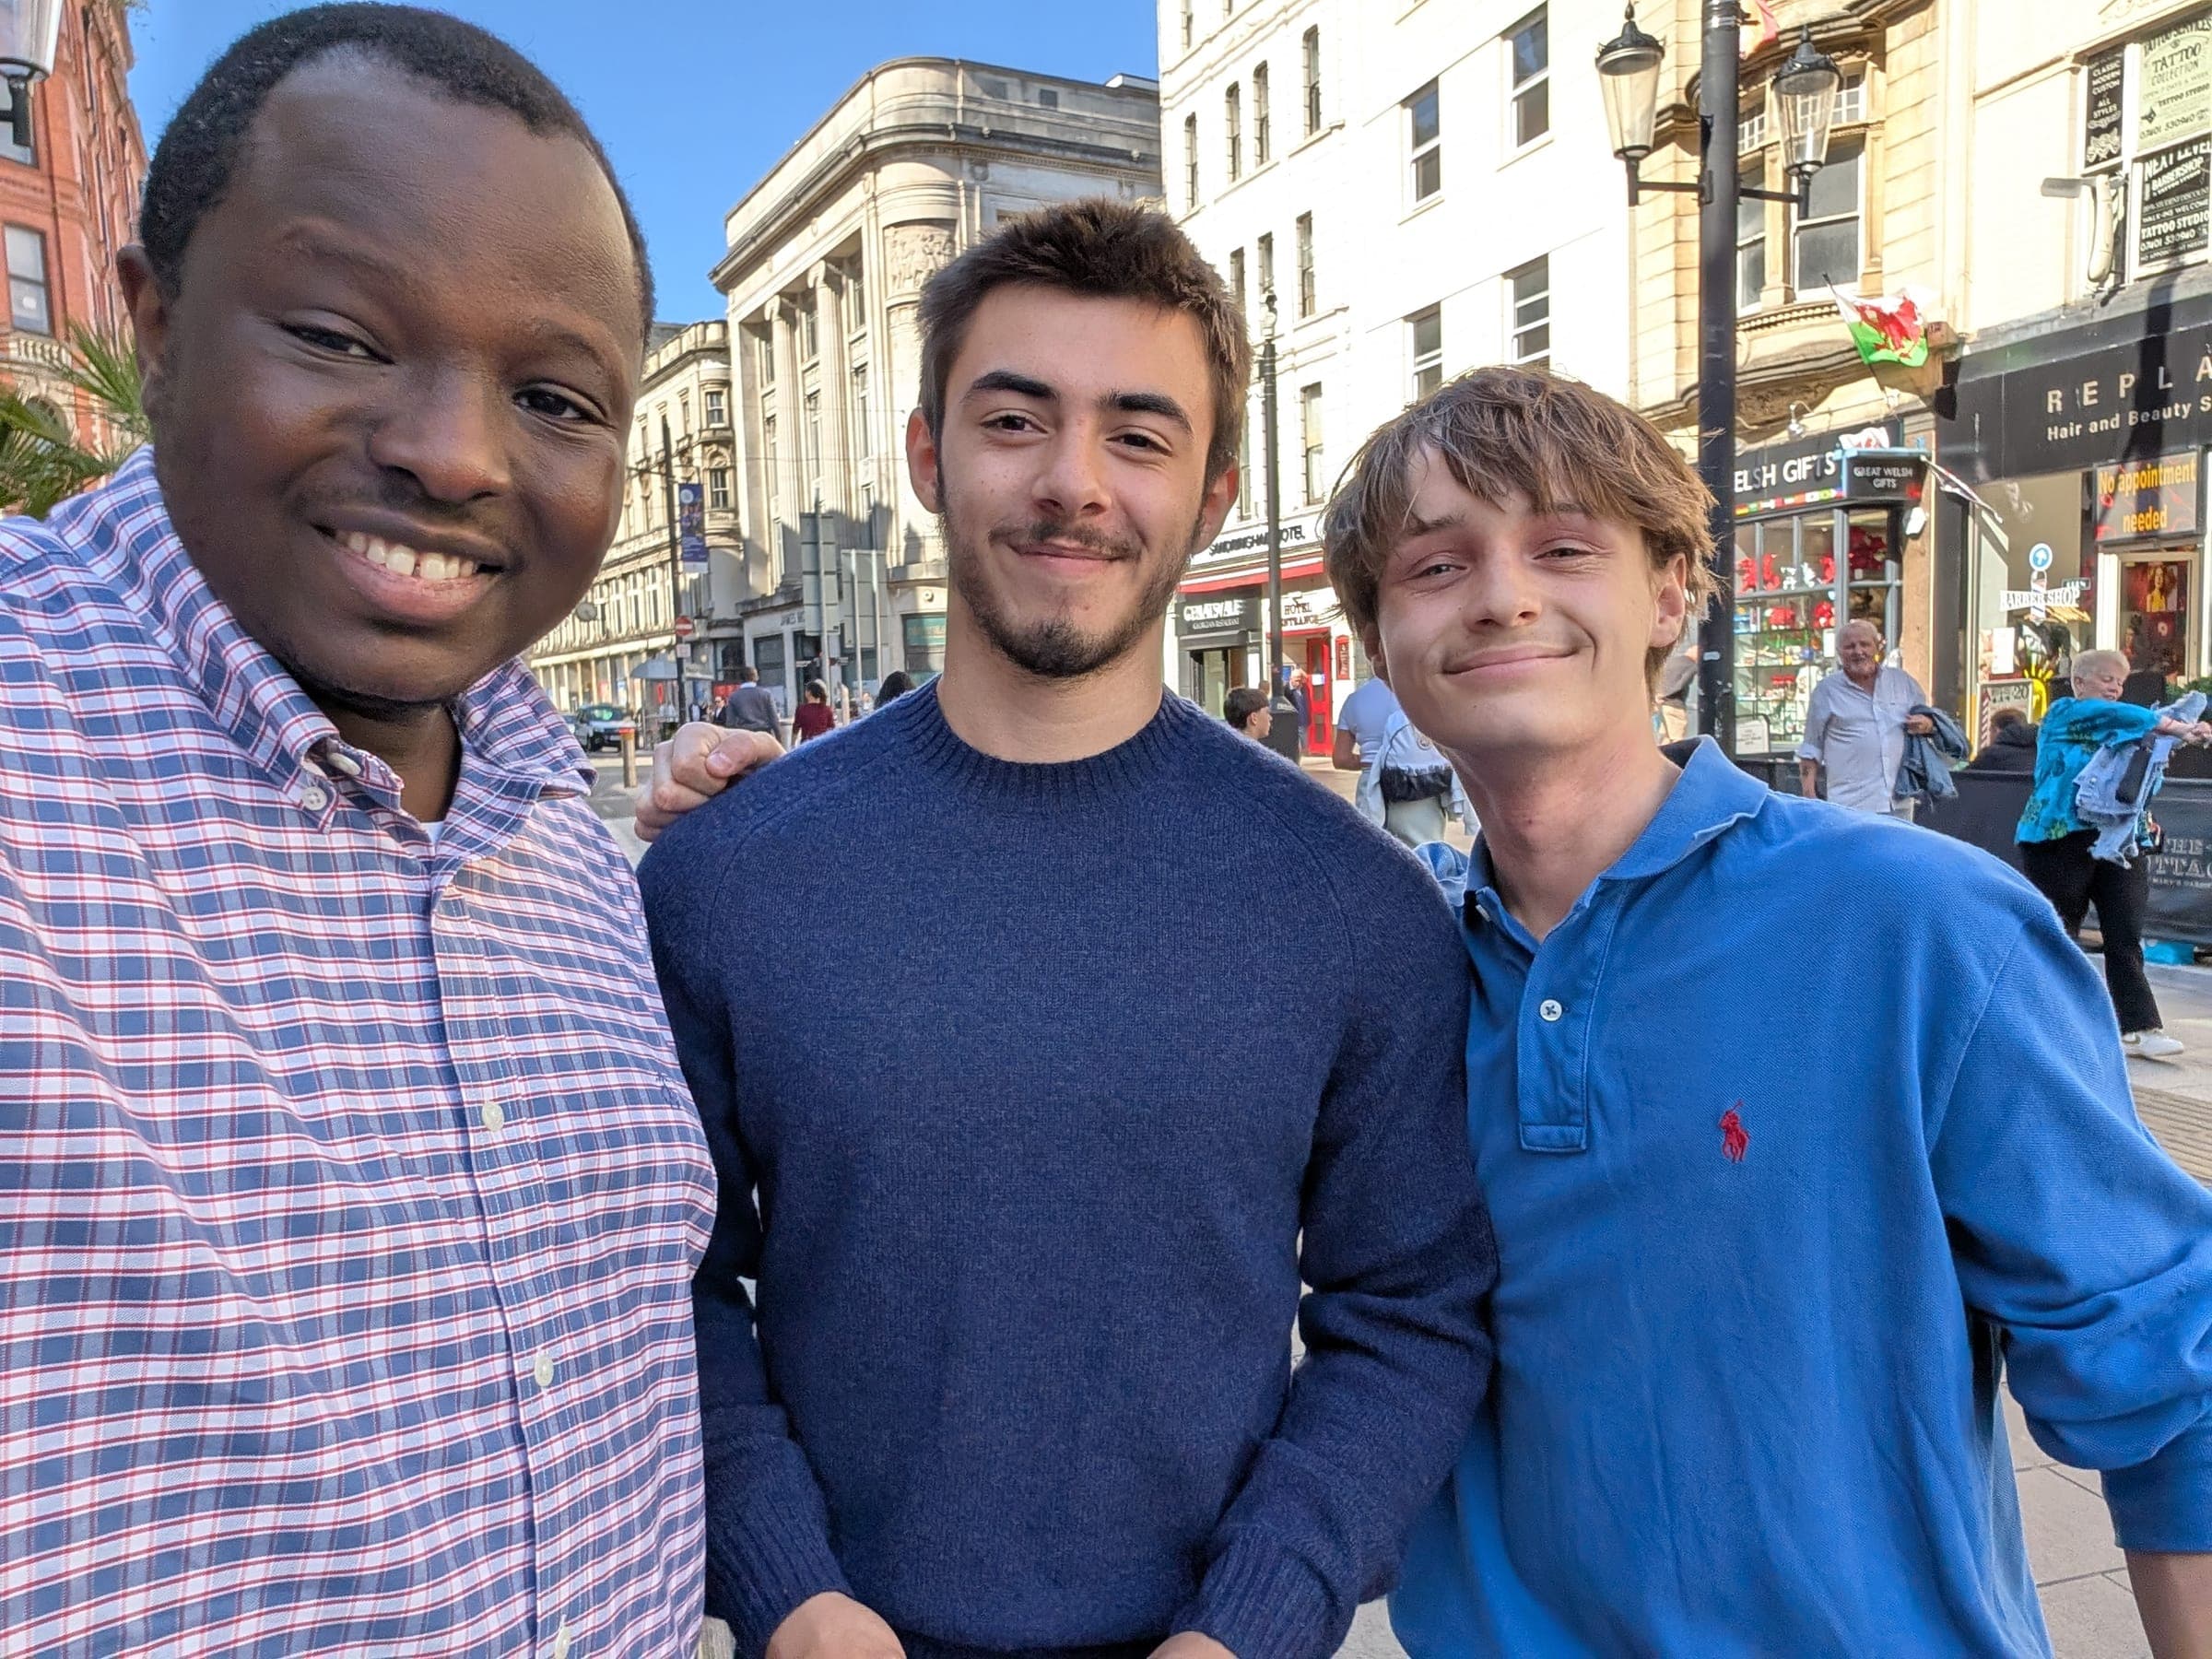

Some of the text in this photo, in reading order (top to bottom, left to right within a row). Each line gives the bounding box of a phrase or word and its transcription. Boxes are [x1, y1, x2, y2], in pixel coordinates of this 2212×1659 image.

[2152, 42, 2201, 73] TATTOO
[2151, 60, 2198, 86] COLLECTION
[2141, 219, 2176, 240] TATTOO
[2176, 210, 2210, 229] STUDIO
[2047, 422, 2082, 441] Hair
[2088, 413, 2120, 433] and
[2128, 402, 2192, 426] Beauty
[1734, 452, 1836, 493] ELSH GIFTS
[1853, 466, 1913, 477] GREAT WELSH
[1873, 478, 1897, 488] GIFTS
[2099, 457, 2196, 497] No appointment
[2123, 504, 2168, 533] needed
[1279, 525, 1305, 543] OTEL
[1284, 602, 1312, 616] HOTEL
[2046, 588, 2080, 606] SHOP
[1280, 615, 1319, 627] NTRANCE
